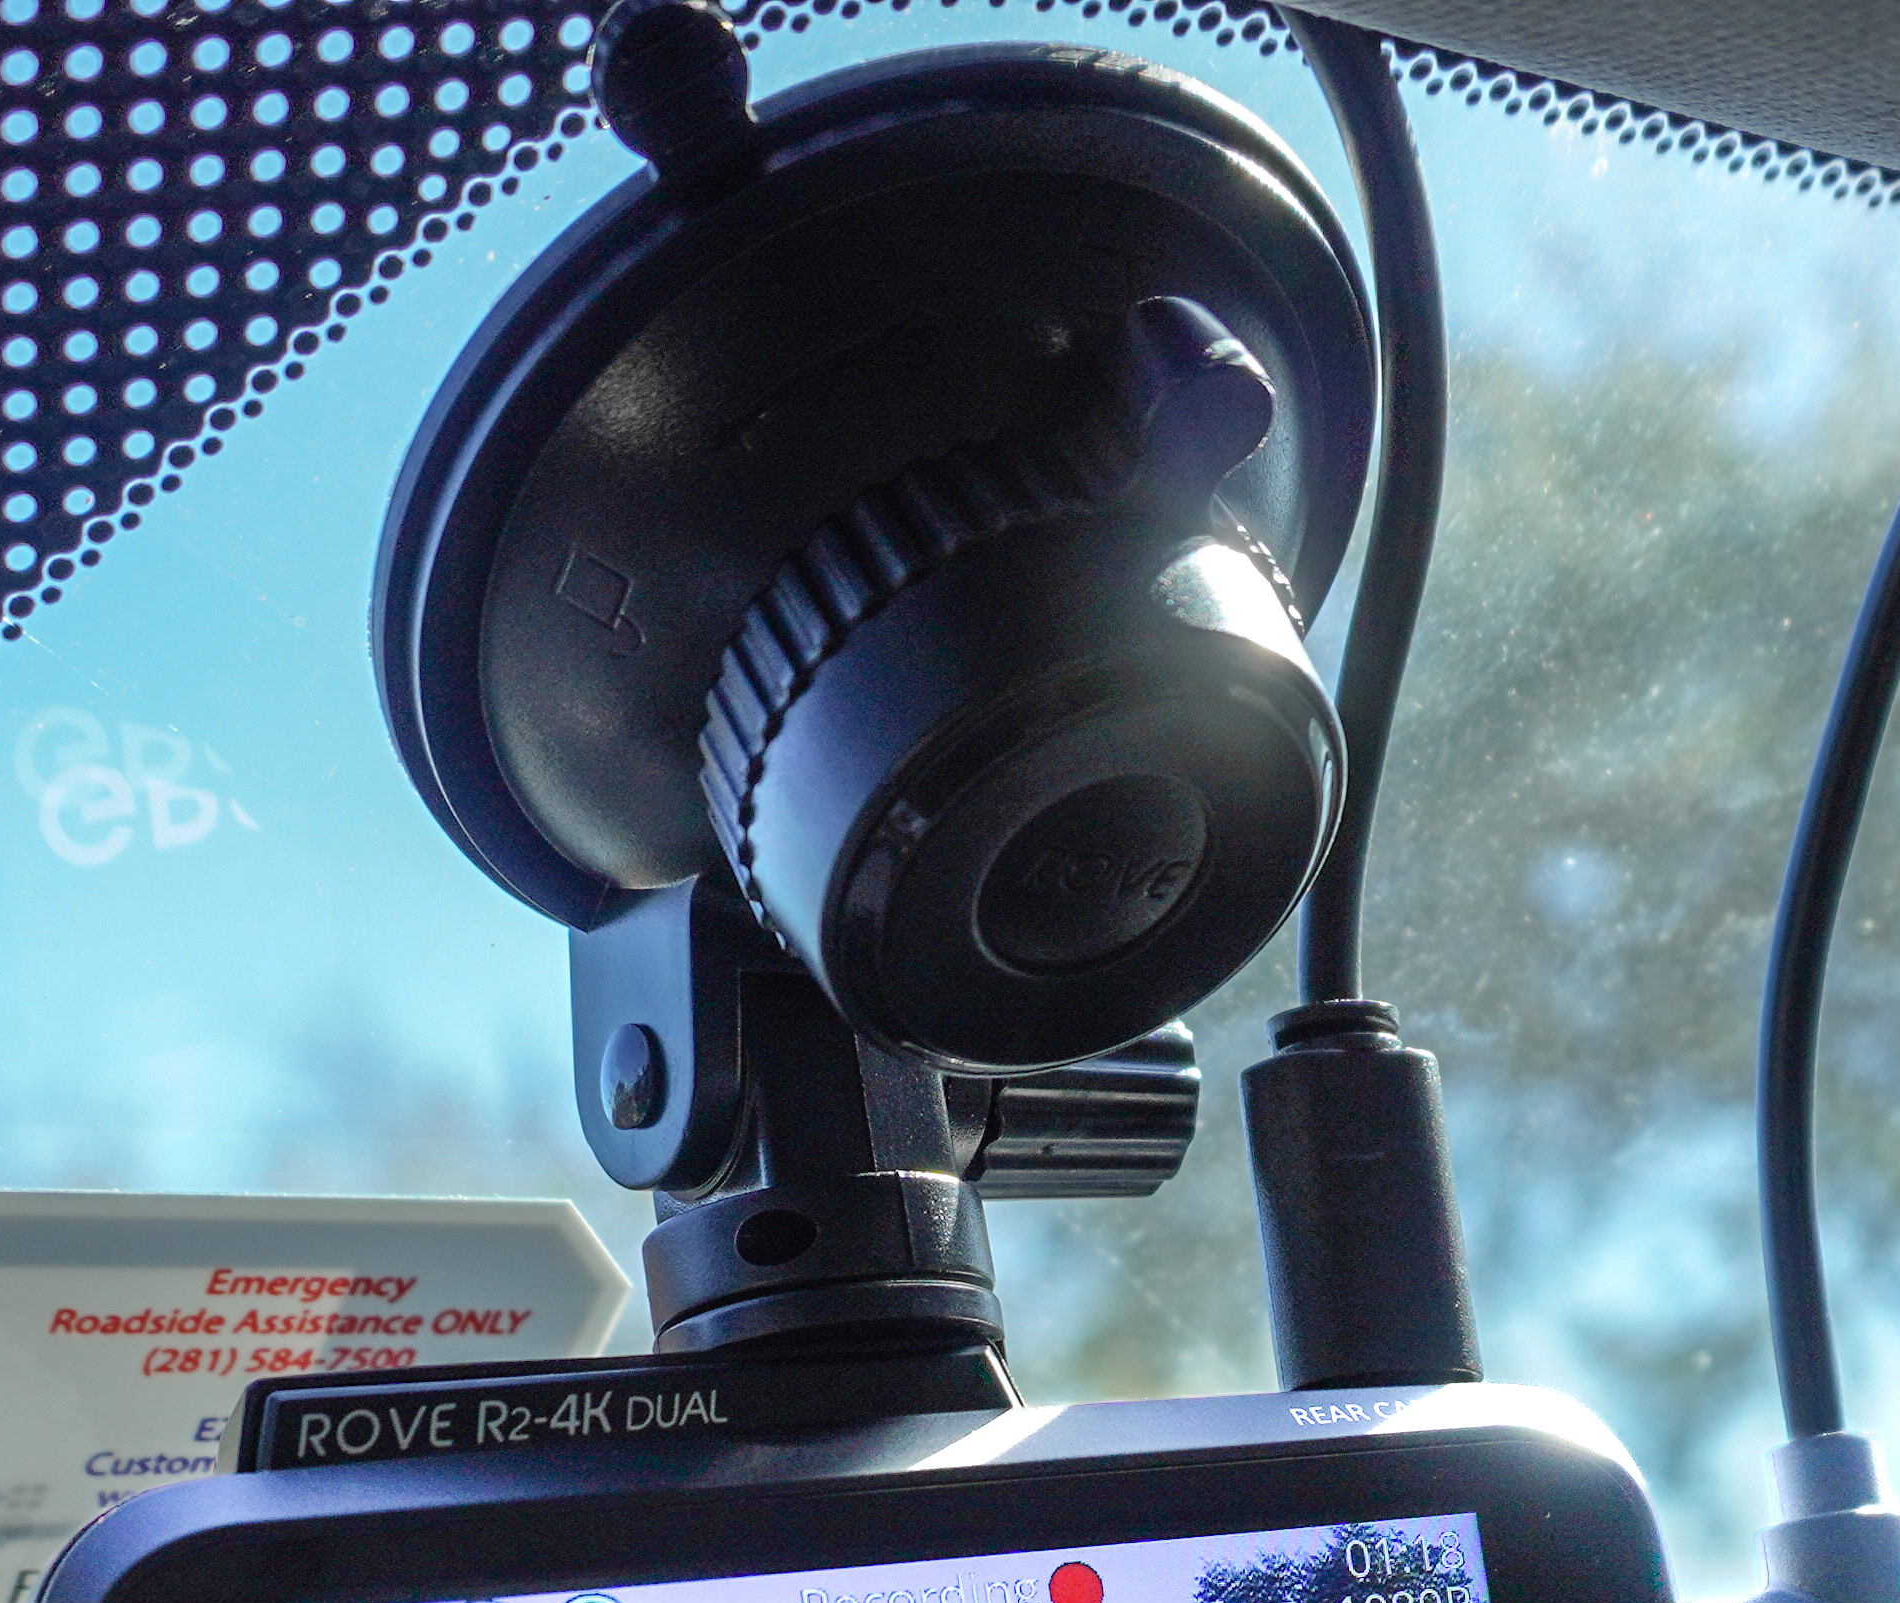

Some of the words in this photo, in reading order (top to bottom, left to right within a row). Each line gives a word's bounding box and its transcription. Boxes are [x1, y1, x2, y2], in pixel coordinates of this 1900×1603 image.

[206, 1268, 417, 1302] Emergency
[50, 1309, 225, 1335] Roadside
[233, 1309, 422, 1335] Assistance
[432, 1309, 531, 1335] ONLY
[143, 1348, 237, 1376] (281)
[245, 1347, 416, 1373] 584-7500
[297, 1403, 457, 1458] ROVE
[476, 1391, 614, 1445] R2-4K
[625, 1390, 728, 1433] DUAL
[1289, 1403, 1372, 1426] REAR
